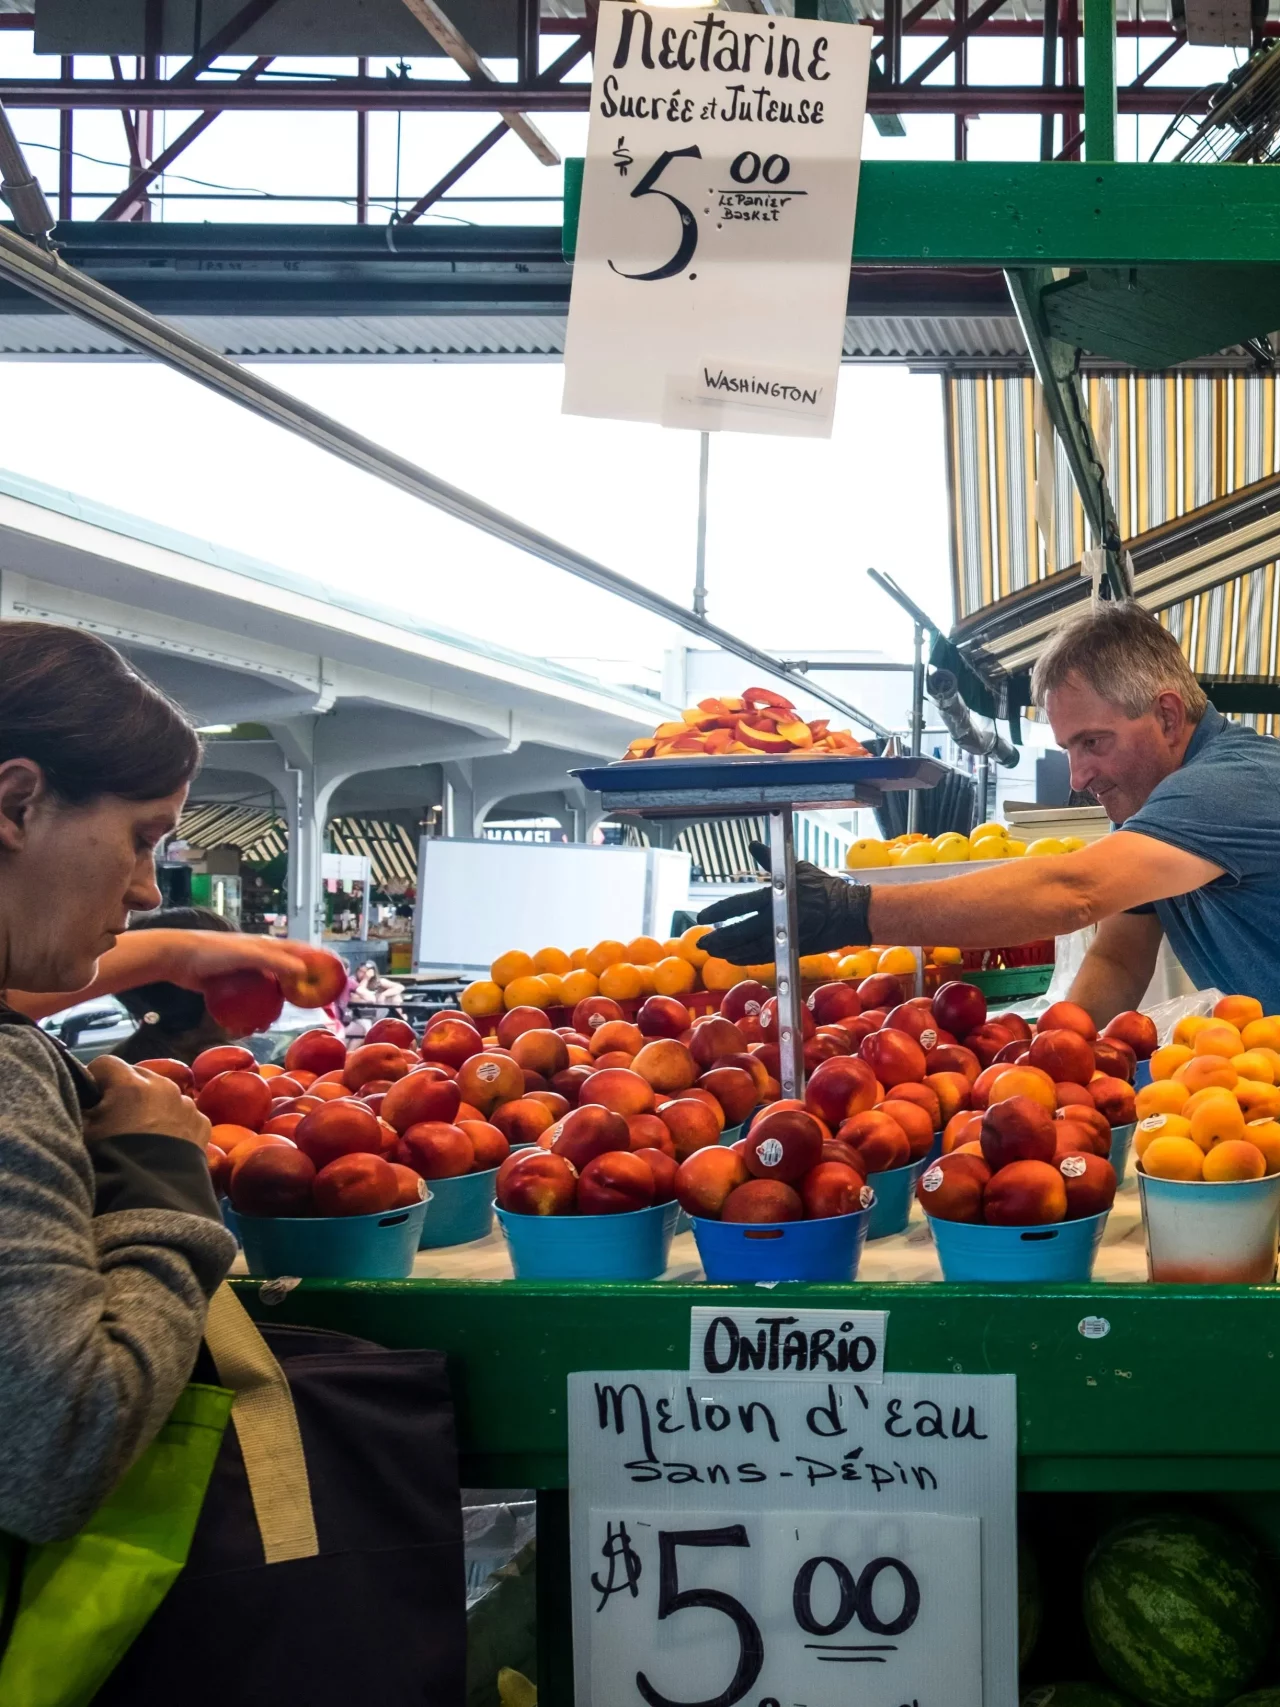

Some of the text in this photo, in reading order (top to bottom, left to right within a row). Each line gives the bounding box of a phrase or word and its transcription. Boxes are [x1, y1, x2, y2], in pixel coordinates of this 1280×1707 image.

[613, 8, 831, 82] Nectarine
[600, 75, 824, 124] Sucrée et Juteuse
[721, 208, 780, 222] Basket
[736, 194, 792, 208] Panier
[703, 1316, 877, 1374] ONTARIO
[594, 1382, 780, 1462] Melon
